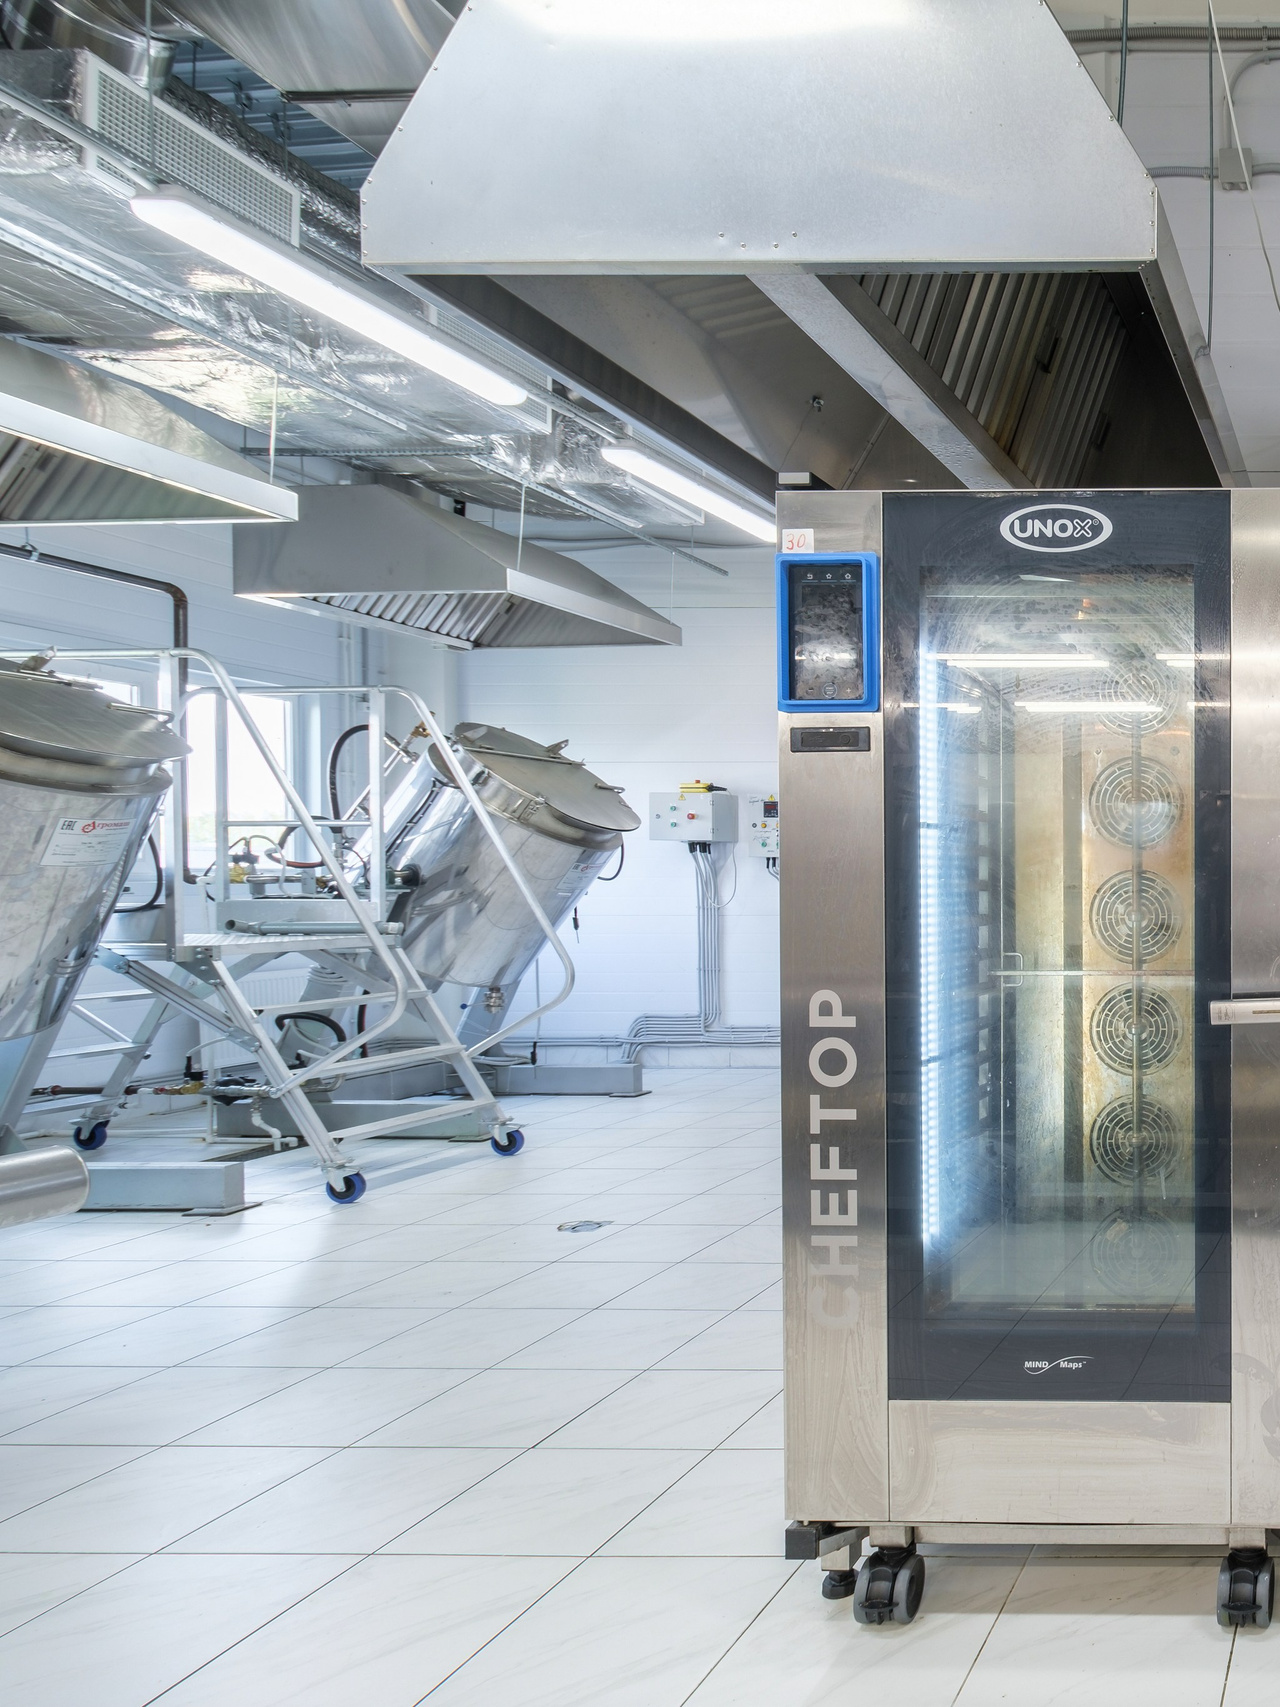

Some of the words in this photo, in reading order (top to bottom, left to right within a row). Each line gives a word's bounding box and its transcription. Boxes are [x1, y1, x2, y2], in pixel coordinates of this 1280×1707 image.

[1013, 519, 1092, 538] UNOX
[786, 533, 807, 551] 30
[809, 989, 860, 1329] CHEFTOP
[1060, 1361, 1083, 1370] Maps
